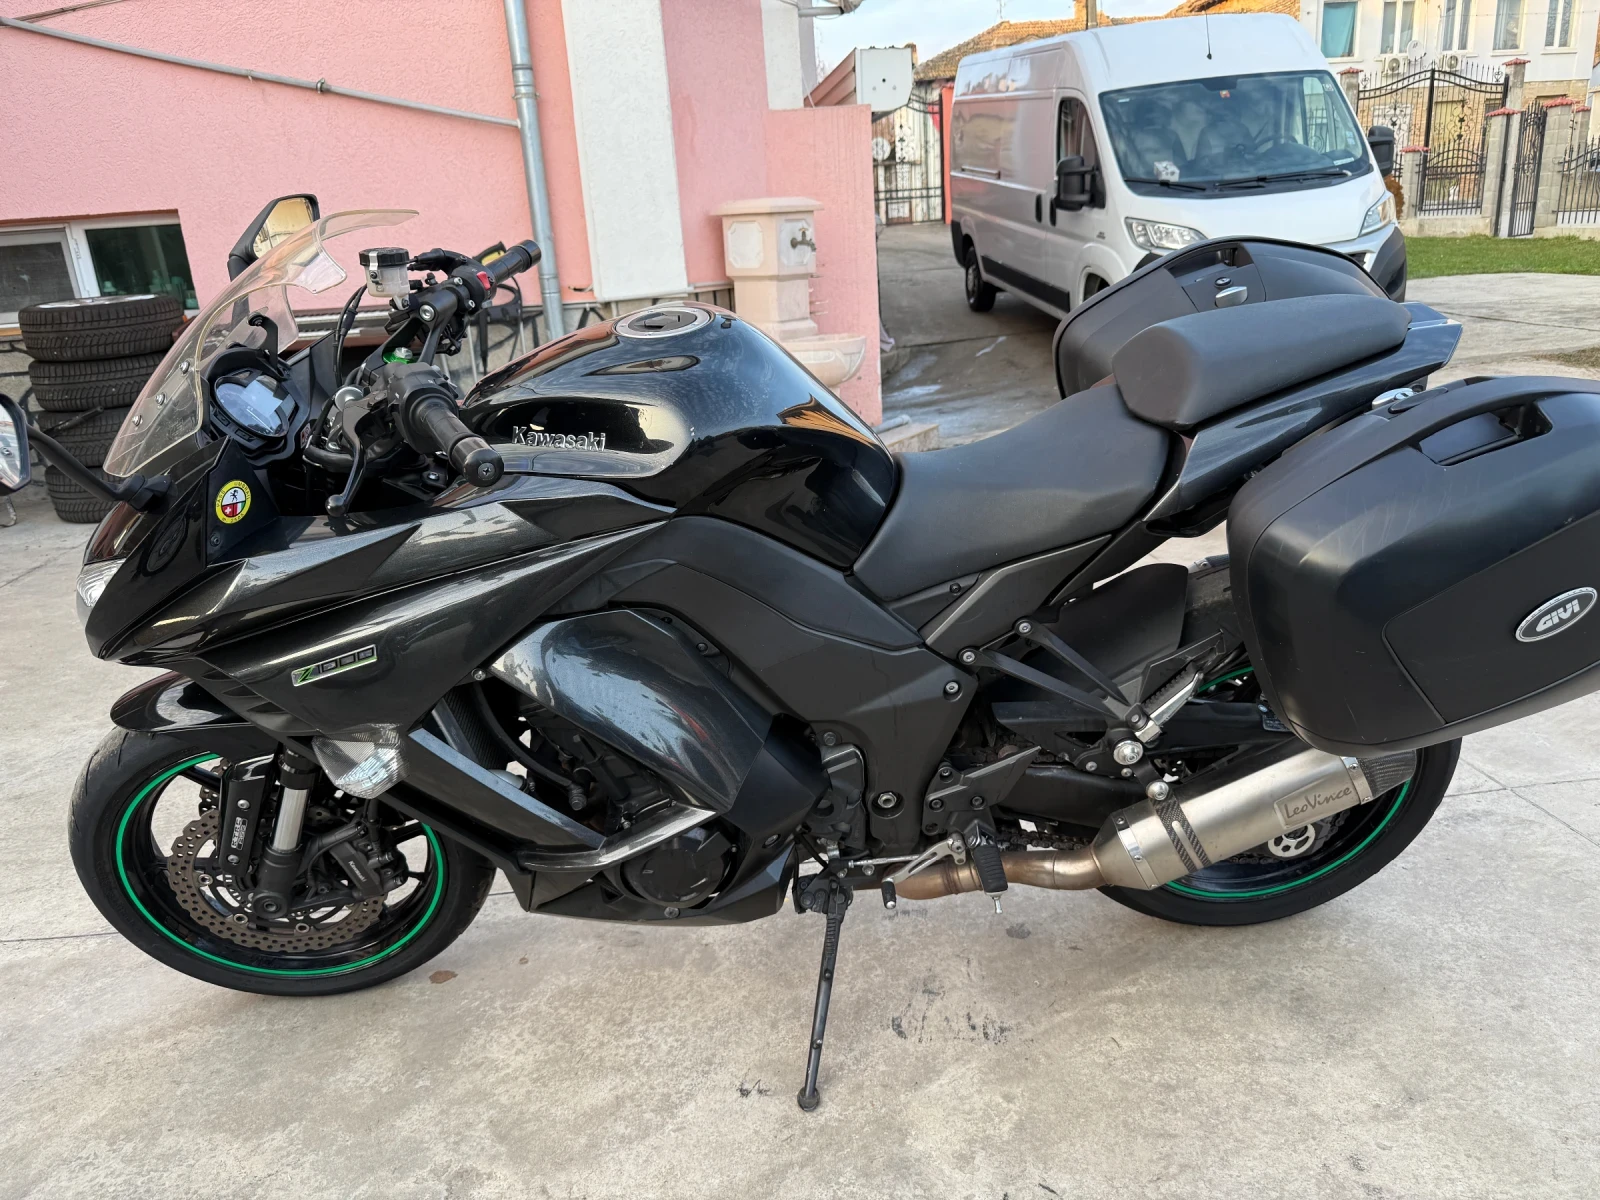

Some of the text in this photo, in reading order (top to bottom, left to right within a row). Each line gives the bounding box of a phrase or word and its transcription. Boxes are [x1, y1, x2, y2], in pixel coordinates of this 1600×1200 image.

[511, 425, 606, 452] Kawasaki
[1535, 598, 1580, 632] GIVI
[1283, 786, 1352, 818] LeoVince
